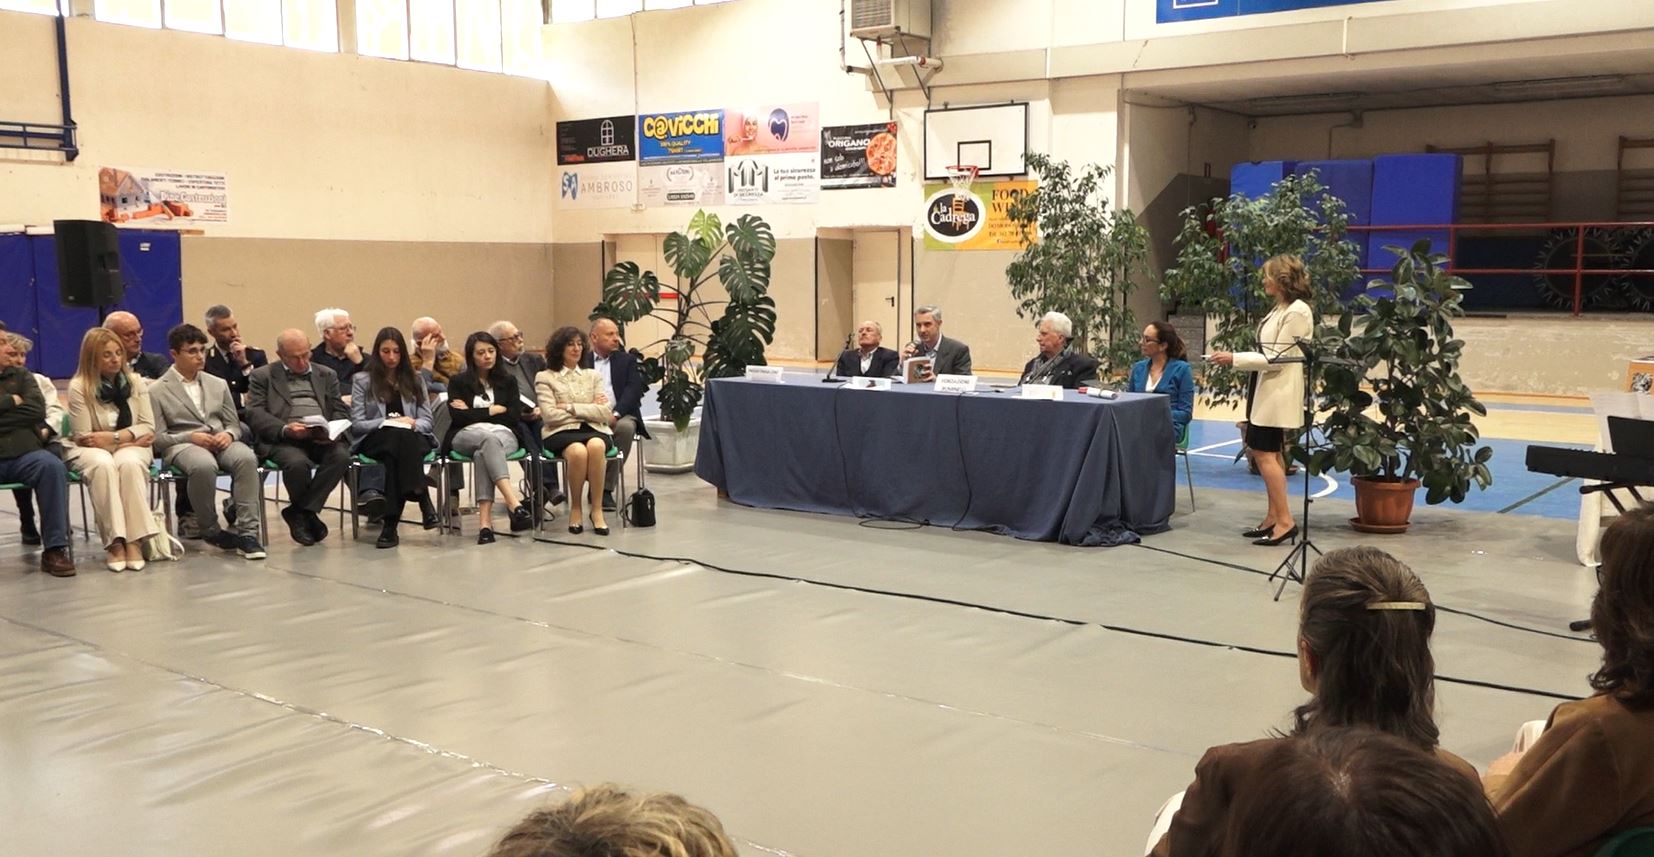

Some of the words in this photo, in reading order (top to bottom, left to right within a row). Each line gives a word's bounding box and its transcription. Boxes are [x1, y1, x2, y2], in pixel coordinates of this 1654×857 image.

[828, 139, 871, 148] ORIGANO
[587, 145, 629, 157] DUGHERA
[581, 180, 633, 193] AMBROSO
[931, 207, 976, 225] Cadrega
